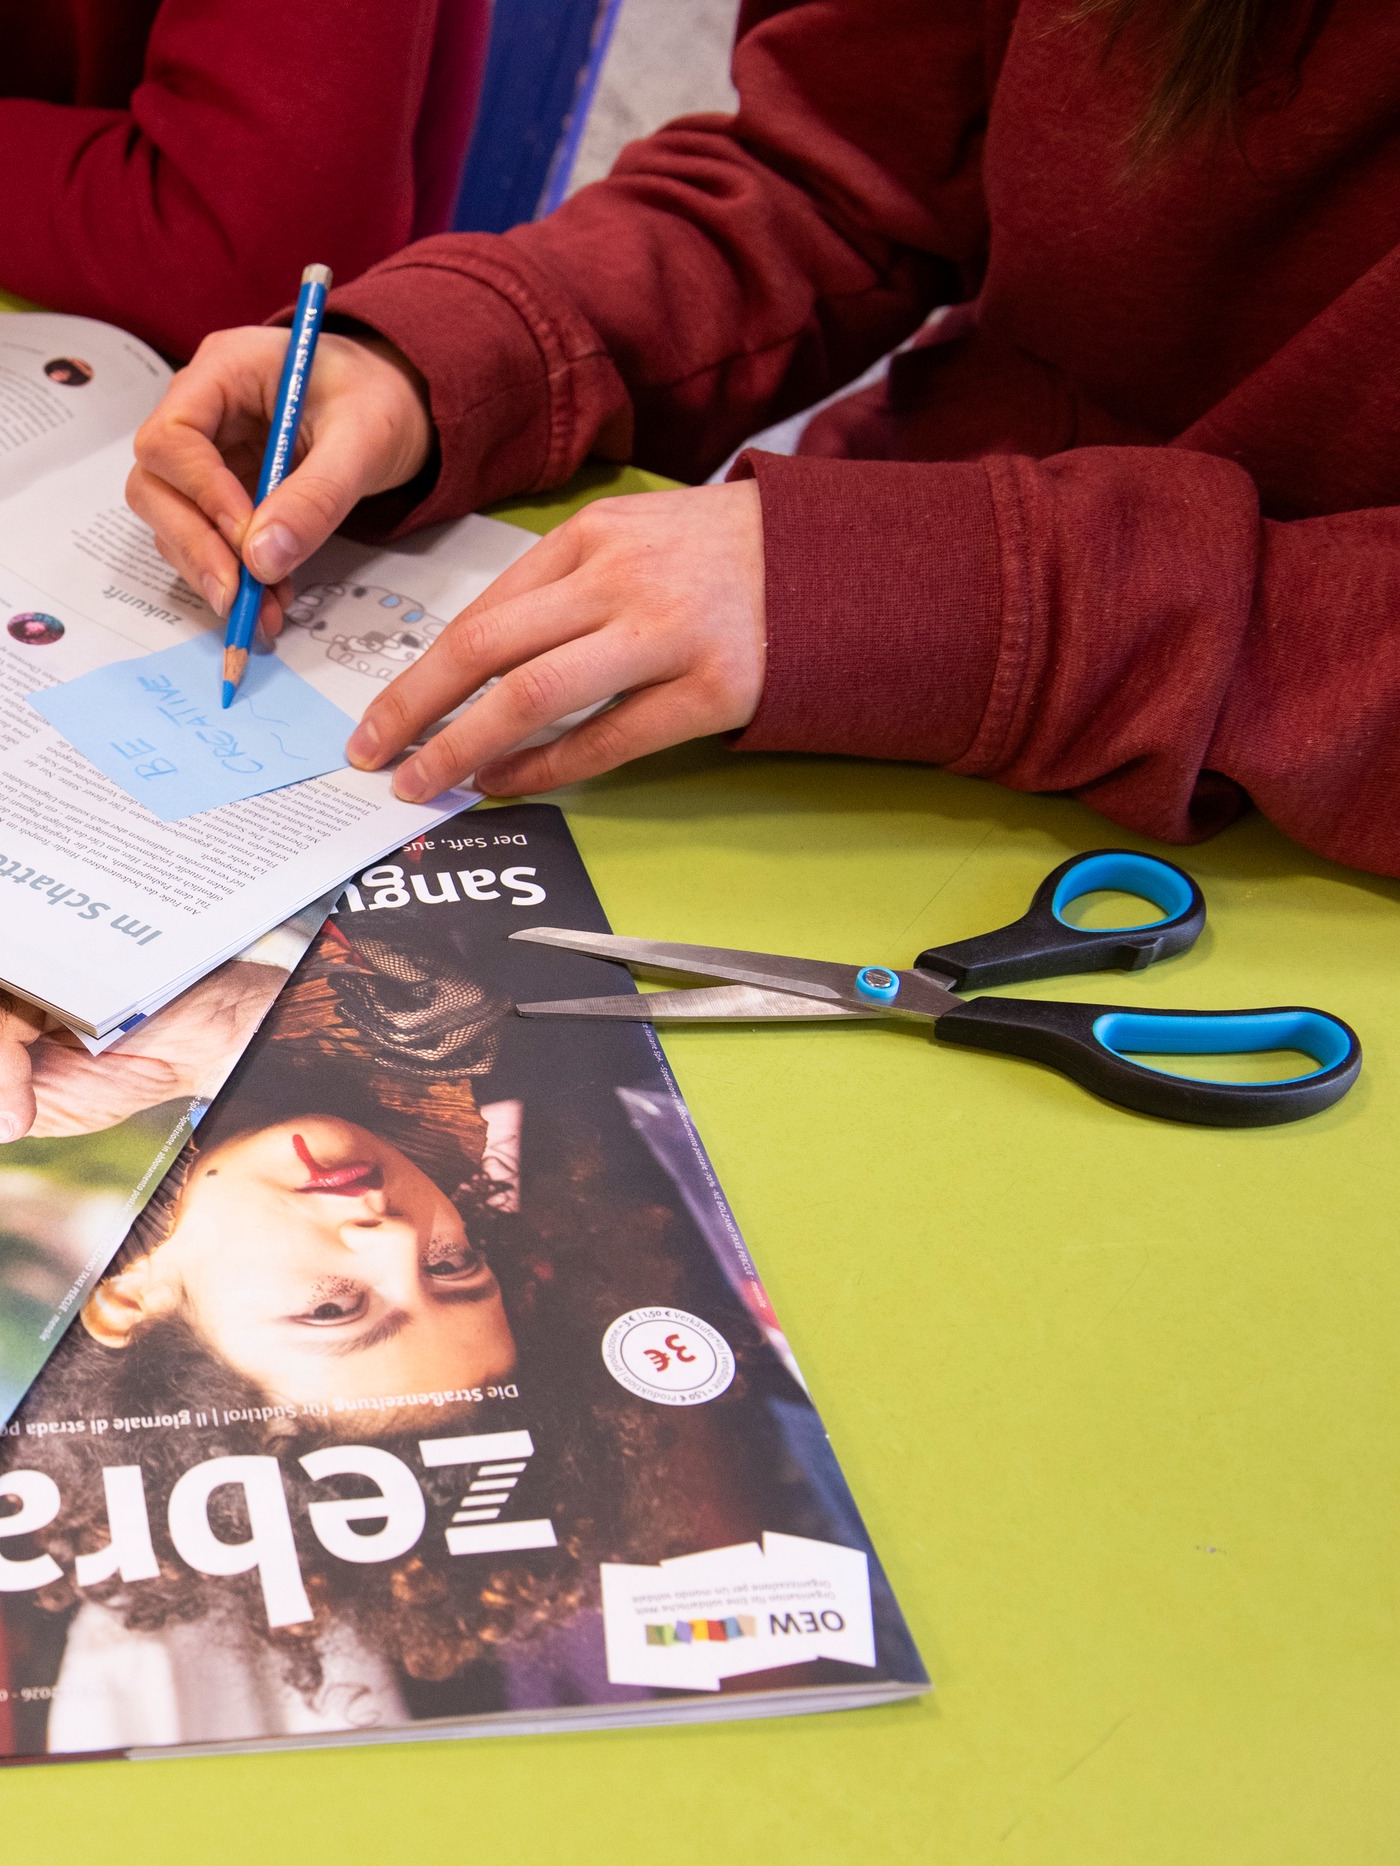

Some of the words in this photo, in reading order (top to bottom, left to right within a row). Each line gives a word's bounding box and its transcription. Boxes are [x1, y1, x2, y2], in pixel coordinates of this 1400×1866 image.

[101, 584, 182, 627] zukunft
[137, 672, 264, 775] CREATIVE
[22, 759, 40, 769] der
[111, 735, 178, 781] BE
[36, 767, 57, 778] Nur
[1, 785, 20, 794] das
[54, 776, 84, 791] Stätte.
[16, 792, 46, 807] Ritual,
[81, 789, 109, 803] dieser
[43, 805, 60, 814] ein
[56, 800, 92, 818] sozialen
[106, 801, 128, 812] Ufer
[64, 815, 85, 826] statt
[88, 815, 111, 826] auch
[217, 807, 271, 833] flussabwärts
[241, 808, 271, 823] eiskalt
[3, 822, 20, 830] im
[9, 812, 76, 844] Vergänglichkeit
[40, 814, 77, 833] heiligen
[107, 824, 130, 835] aber
[210, 815, 249, 834] Szenerie
[71, 830, 89, 839] des
[188, 826, 206, 836] von
[202, 822, 247, 844] verbrannt
[246, 831, 266, 841] Die
[280, 825, 304, 837] läuft
[314, 829, 333, 839] des
[17, 827, 83, 860] Hindu-Tempels
[72, 842, 89, 851] die
[85, 837, 108, 848] Ufer
[126, 832, 176, 857] Traditionen
[204, 833, 229, 846] mich
[267, 829, 312, 851] Überreste
[301, 834, 322, 845] Mir
[403, 839, 435, 852] aus
[441, 837, 487, 850] Saft,
[493, 834, 527, 846] Der
[105, 845, 122, 853] am
[211, 847, 228, 856] am
[226, 844, 256, 859] trennt
[245, 841, 290, 863] terhaufen
[263, 838, 301, 857] werden.
[86, 849, 110, 861] wird
[118, 851, 143, 864] Hier,
[226, 854, 253, 868] stehe
[174, 854, 232, 882] verwurzelten
[197, 852, 260, 882] widerspiegelt.
[253, 856, 280, 869] Fluss
[79, 858, 143, 889] bedeutendsten
[108, 858, 176, 891] Pashupatinath,
[140, 862, 185, 884] zelebriert.
[173, 865, 207, 882] rituelle
[250, 866, 269, 876] Ich
[204, 880, 237, 896] finden
[227, 878, 247, 889] tief
[140, 887, 159, 896] des
[171, 889, 196, 901] dem
[180, 881, 225, 903] öffentlich
[157, 894, 183, 908] Fuße
[192, 898, 215, 910] Tal,
[181, 906, 202, 917] Am
[110, 913, 163, 946] Im
[487, 1384, 519, 1400] Die
[335, 1385, 484, 1416] Straßenzeitung
[224, 1404, 298, 1426] Südtirol
[303, 1403, 329, 1419] für
[91, 1419, 109, 1435] di
[113, 1410, 191, 1433] giornale
[26, 1420, 86, 1439] strada
[769, 1609, 846, 1636] OEW
